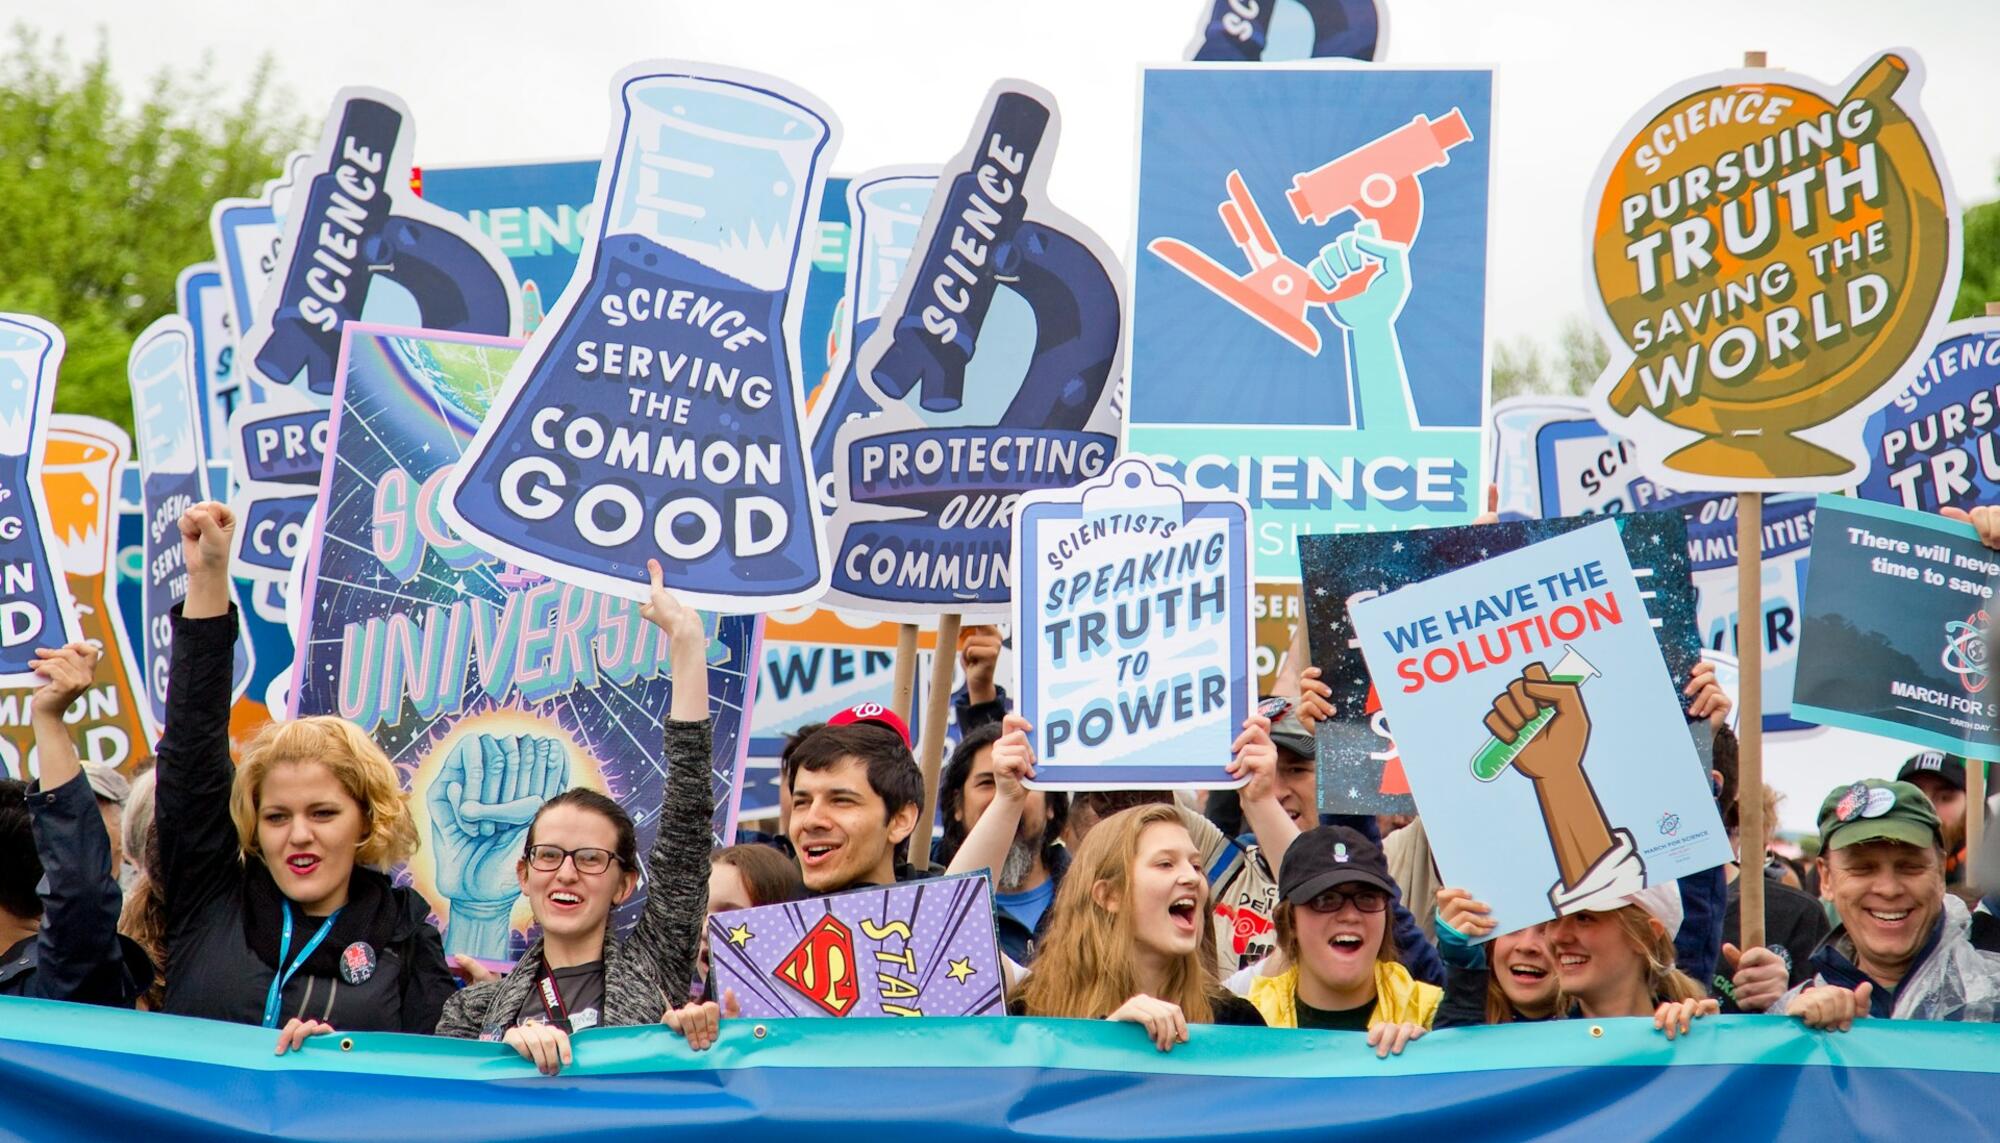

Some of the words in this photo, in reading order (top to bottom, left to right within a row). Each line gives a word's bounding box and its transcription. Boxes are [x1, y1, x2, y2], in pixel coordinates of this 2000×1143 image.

[1622, 99, 1875, 236] PURSUING
[1634, 93, 1793, 176] SCIENCE
[299, 135, 382, 333] SCIENCE
[921, 133, 1024, 344] SCIENCE
[1625, 142, 1881, 296] TRUTH
[601, 287, 767, 352] SCIENCE
[1632, 261, 1793, 353] SAVING
[1808, 221, 1886, 277] THE
[575, 341, 773, 409] SERVING
[1638, 273, 1891, 411] WORLD
[531, 406, 782, 485] COMMON
[627, 387, 691, 425] THE
[862, 436, 1106, 483] PROTECTING
[500, 456, 789, 561] GOOD
[938, 494, 1024, 530] OUR
[1047, 513, 1178, 571] SCIENTISTS
[1046, 532, 1225, 612] SPEAKING
[1848, 526, 1911, 555] There
[1915, 541, 1951, 564] will
[1955, 550, 2000, 577] neve
[1871, 556, 1920, 581] time
[1923, 567, 1945, 587] to
[1948, 575, 1994, 601] save
[1045, 574, 1225, 661] TRUTH
[1383, 615, 1443, 654] WE
[1445, 584, 1539, 636] HAVE
[1538, 560, 1608, 602] THE
[1397, 591, 1624, 694] SOLUTION
[1117, 650, 1149, 682] TO
[1891, 680, 1949, 709] MARCH
[1950, 696, 1983, 717] FOR
[1046, 674, 1226, 758] POWER
[1949, 716, 1974, 731] EARTH
[1974, 723, 1990, 733] DAY
